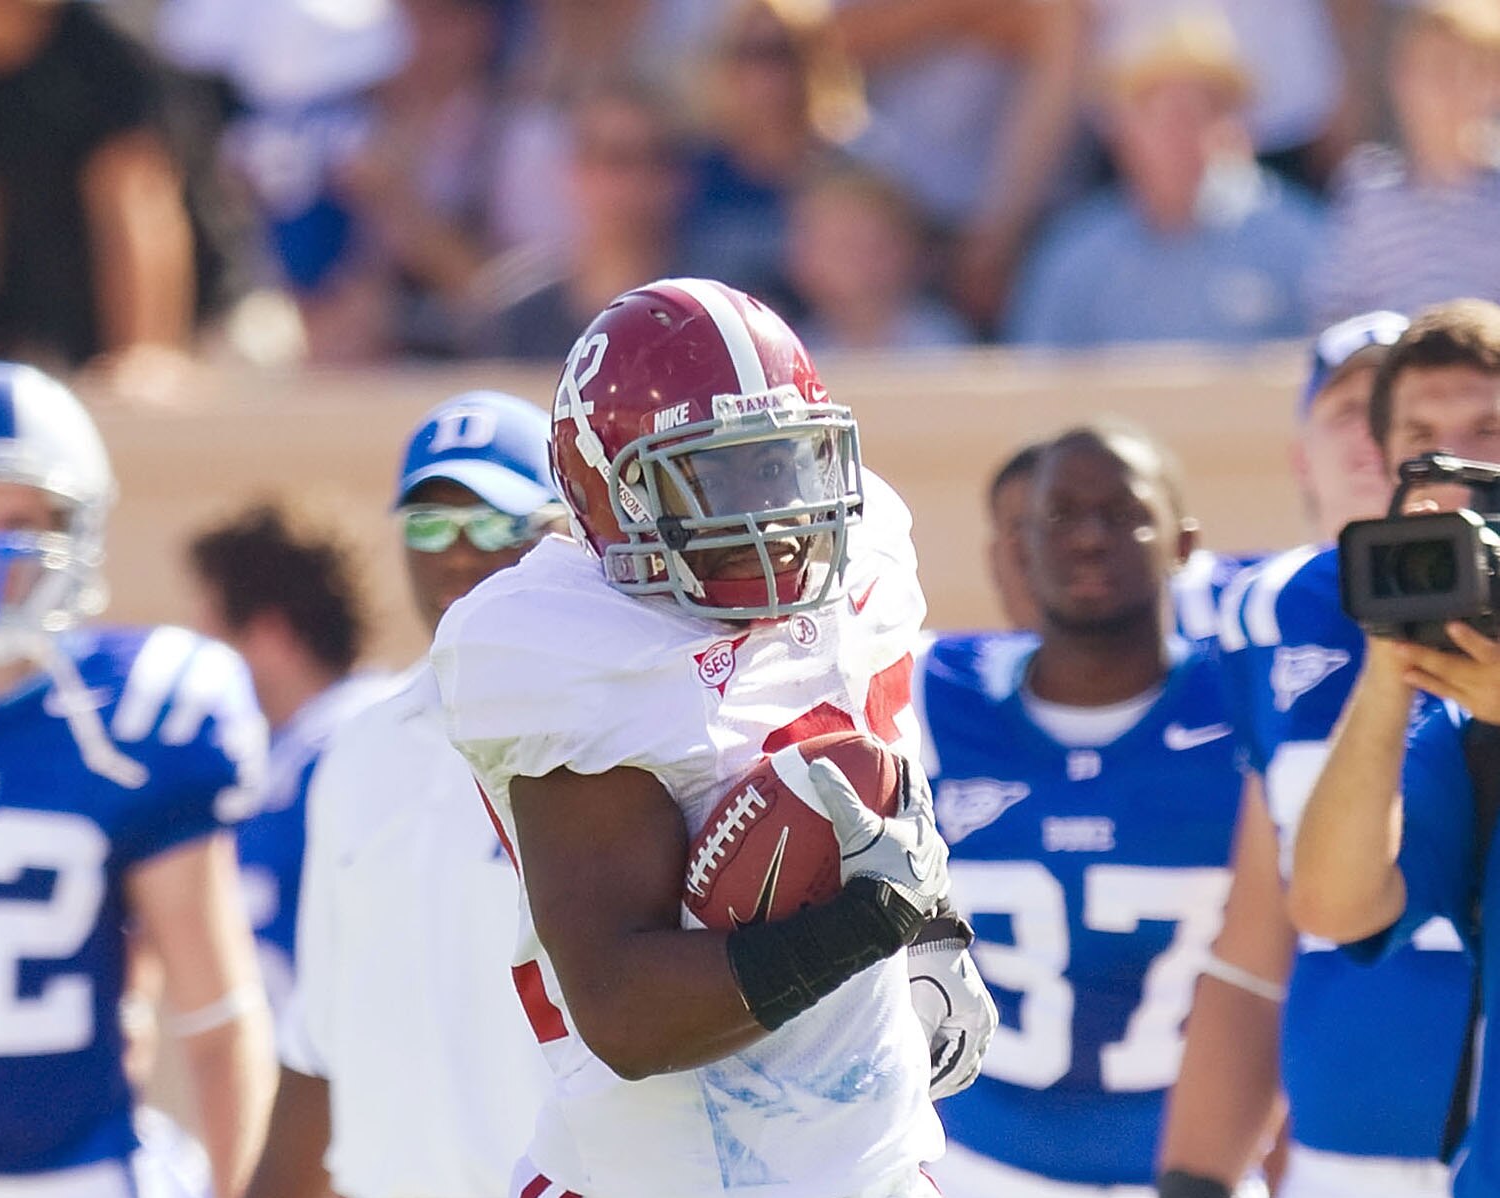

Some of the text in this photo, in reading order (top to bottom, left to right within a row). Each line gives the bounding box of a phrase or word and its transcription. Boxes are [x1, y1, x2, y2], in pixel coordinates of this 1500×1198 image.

[653, 402, 690, 434] NIKE
[735, 396, 783, 414] BAMA
[704, 652, 732, 678] SEC
